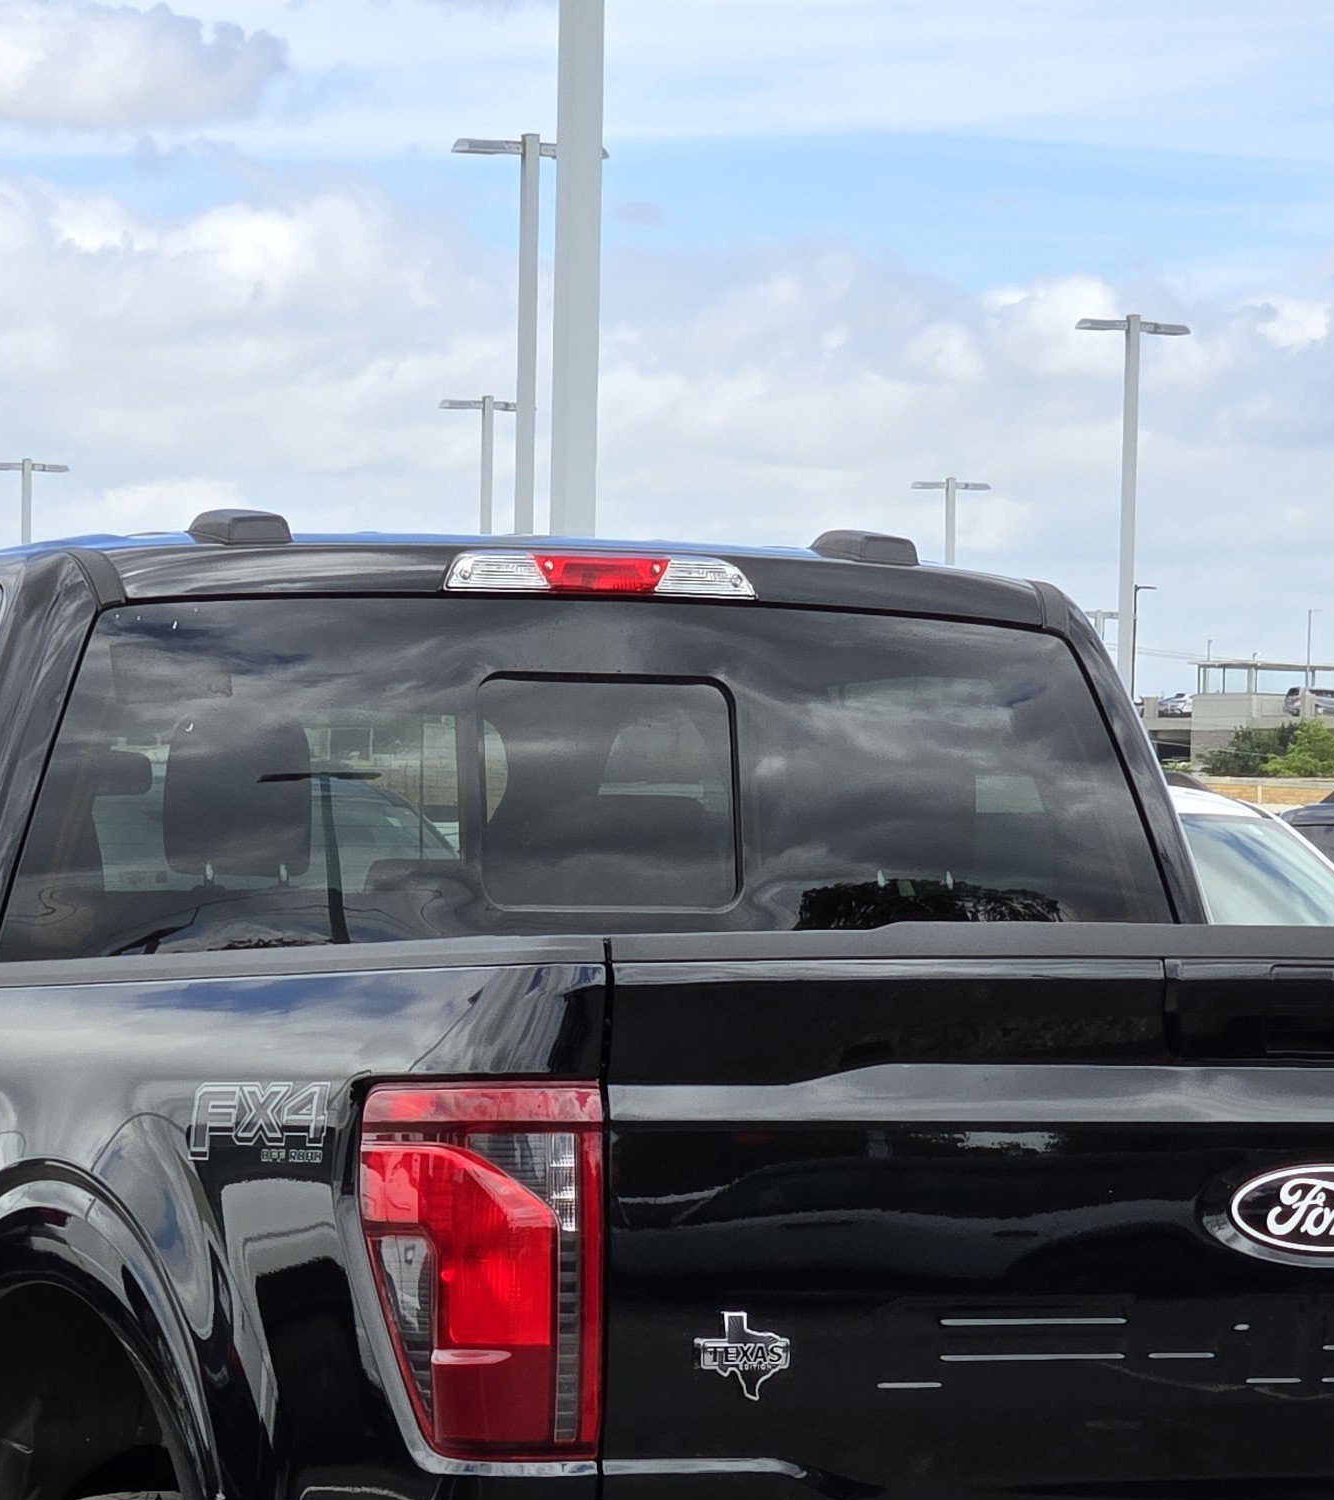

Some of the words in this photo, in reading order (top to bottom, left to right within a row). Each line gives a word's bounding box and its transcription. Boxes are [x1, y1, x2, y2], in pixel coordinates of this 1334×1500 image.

[187, 1081, 331, 1160] FX4
[261, 1149, 286, 1162] OFF
[289, 1149, 323, 1163] ROAD
[706, 1344, 784, 1363] TEXAS
